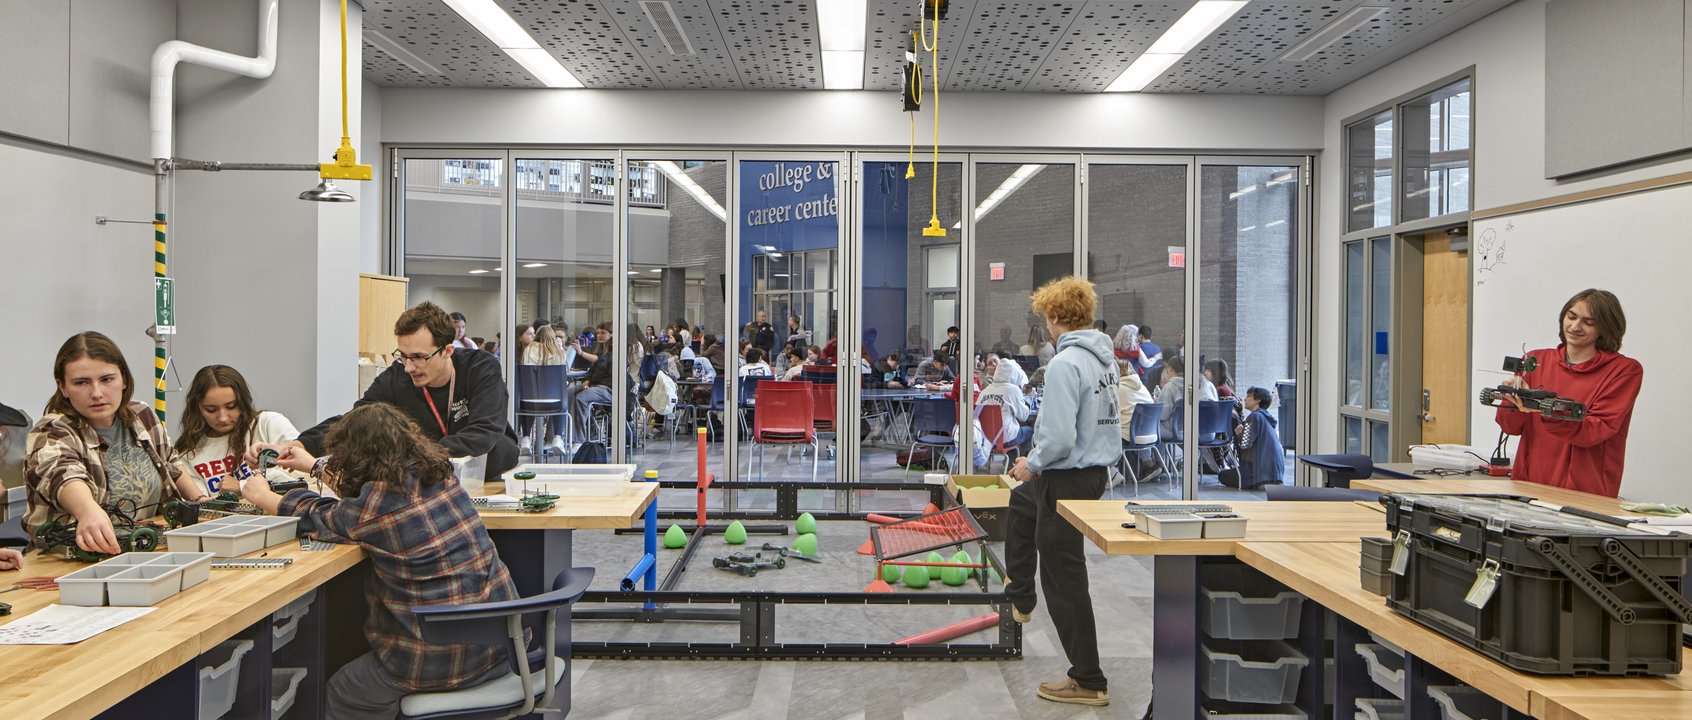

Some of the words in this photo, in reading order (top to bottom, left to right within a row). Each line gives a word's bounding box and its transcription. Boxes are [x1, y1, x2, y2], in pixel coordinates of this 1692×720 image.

[759, 162, 812, 192] college
[816, 162, 832, 180] &
[747, 205, 792, 226] career
[795, 193, 838, 220] cente
[974, 511, 997, 520] VEX
